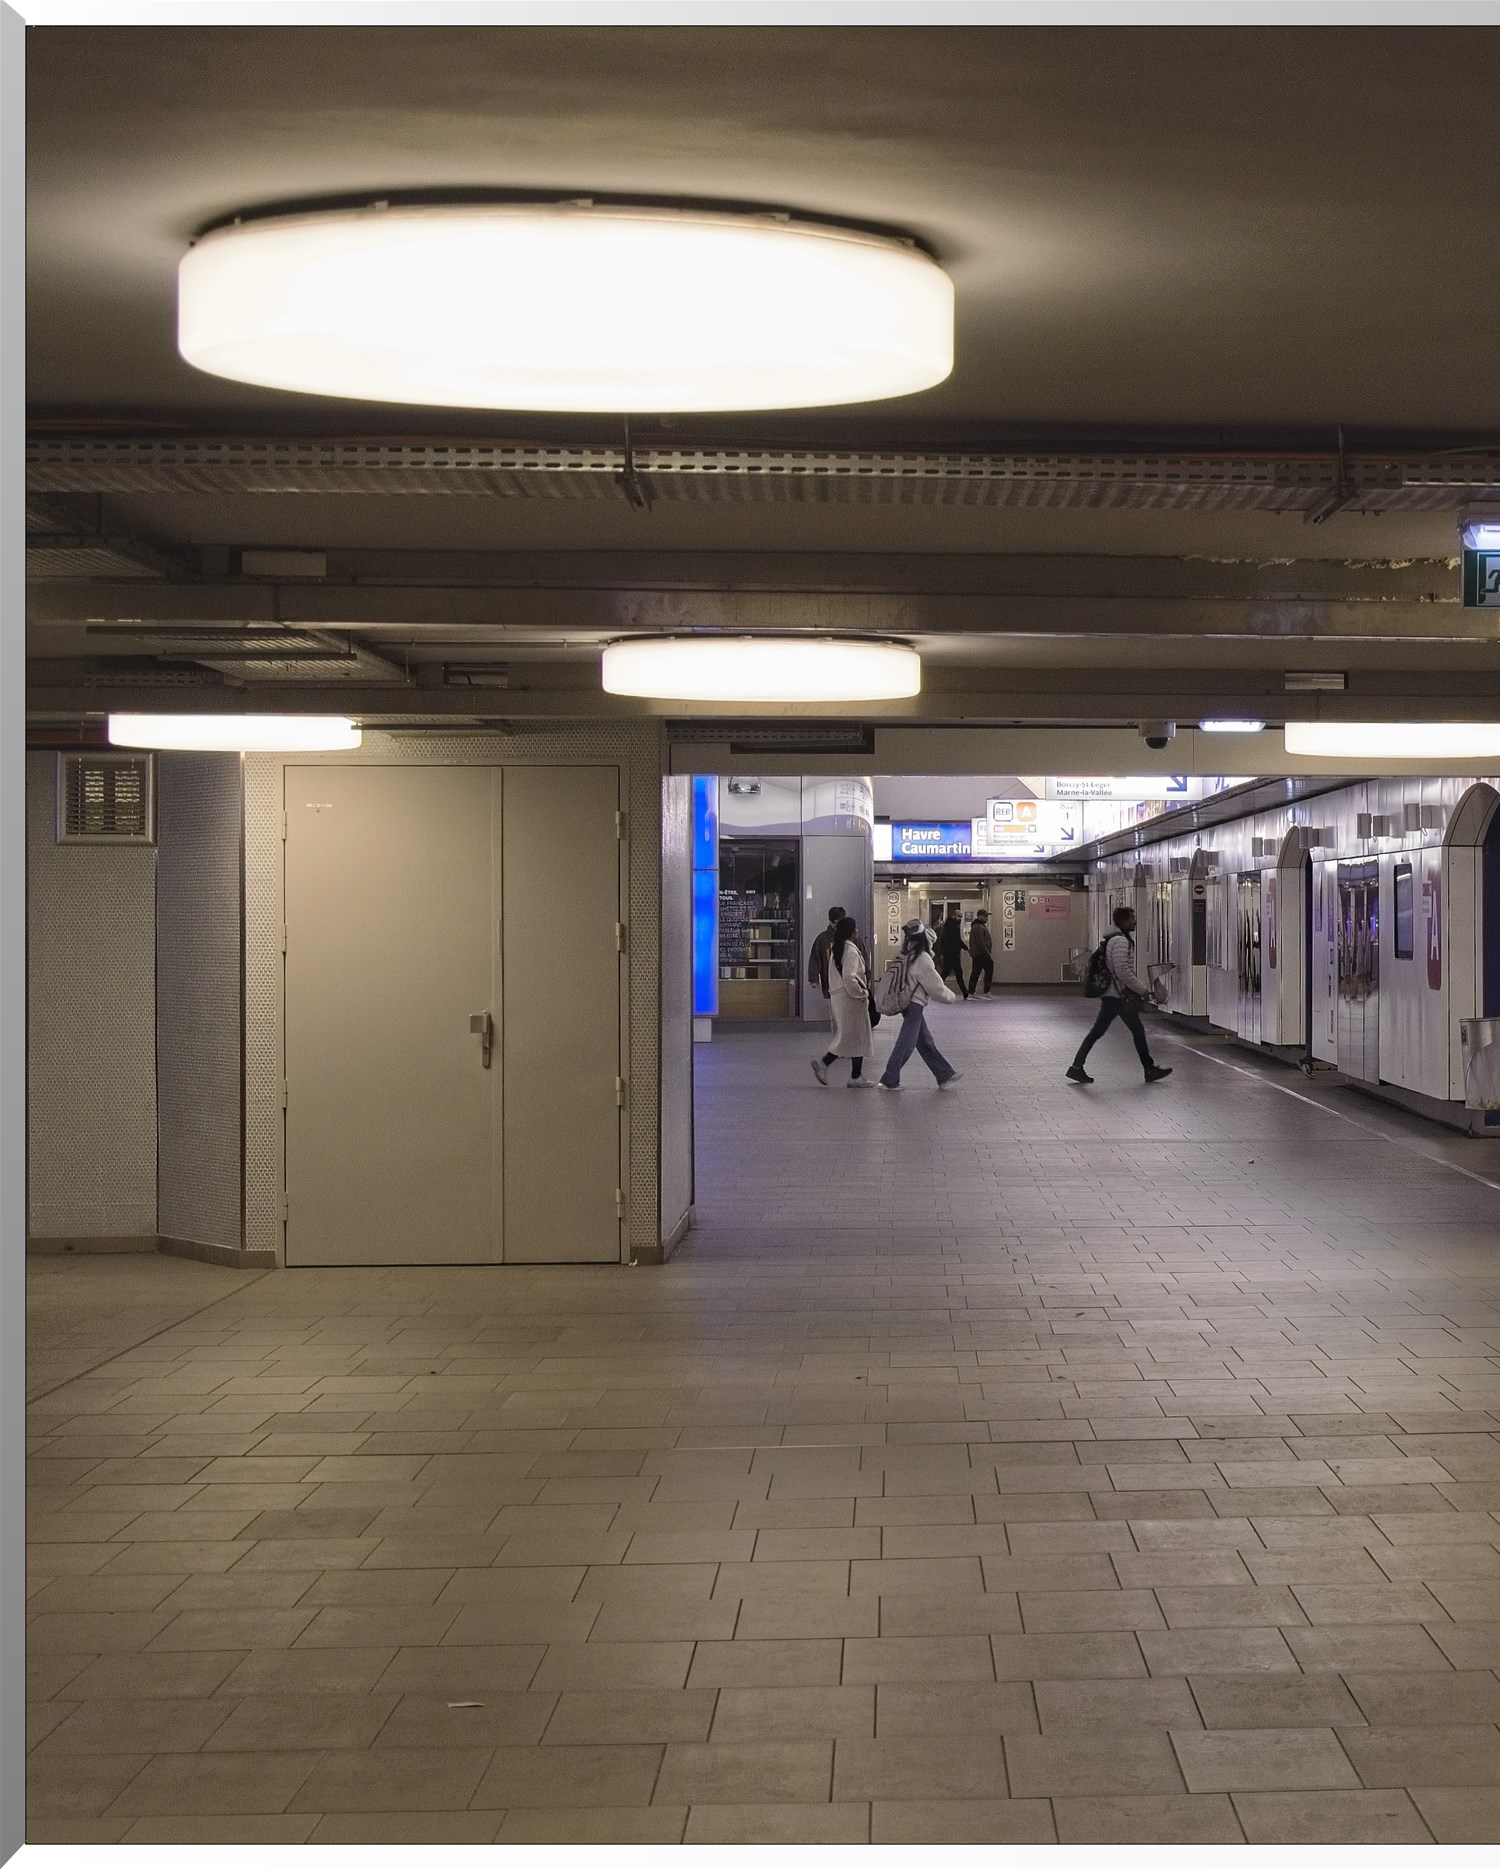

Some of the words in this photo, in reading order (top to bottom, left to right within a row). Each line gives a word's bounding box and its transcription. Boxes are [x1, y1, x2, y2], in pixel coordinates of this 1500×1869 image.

[995, 807, 1011, 816] RER
[1021, 807, 1032, 818] A
[901, 828, 941, 840] Havre
[901, 843, 971, 855] Caumartin
